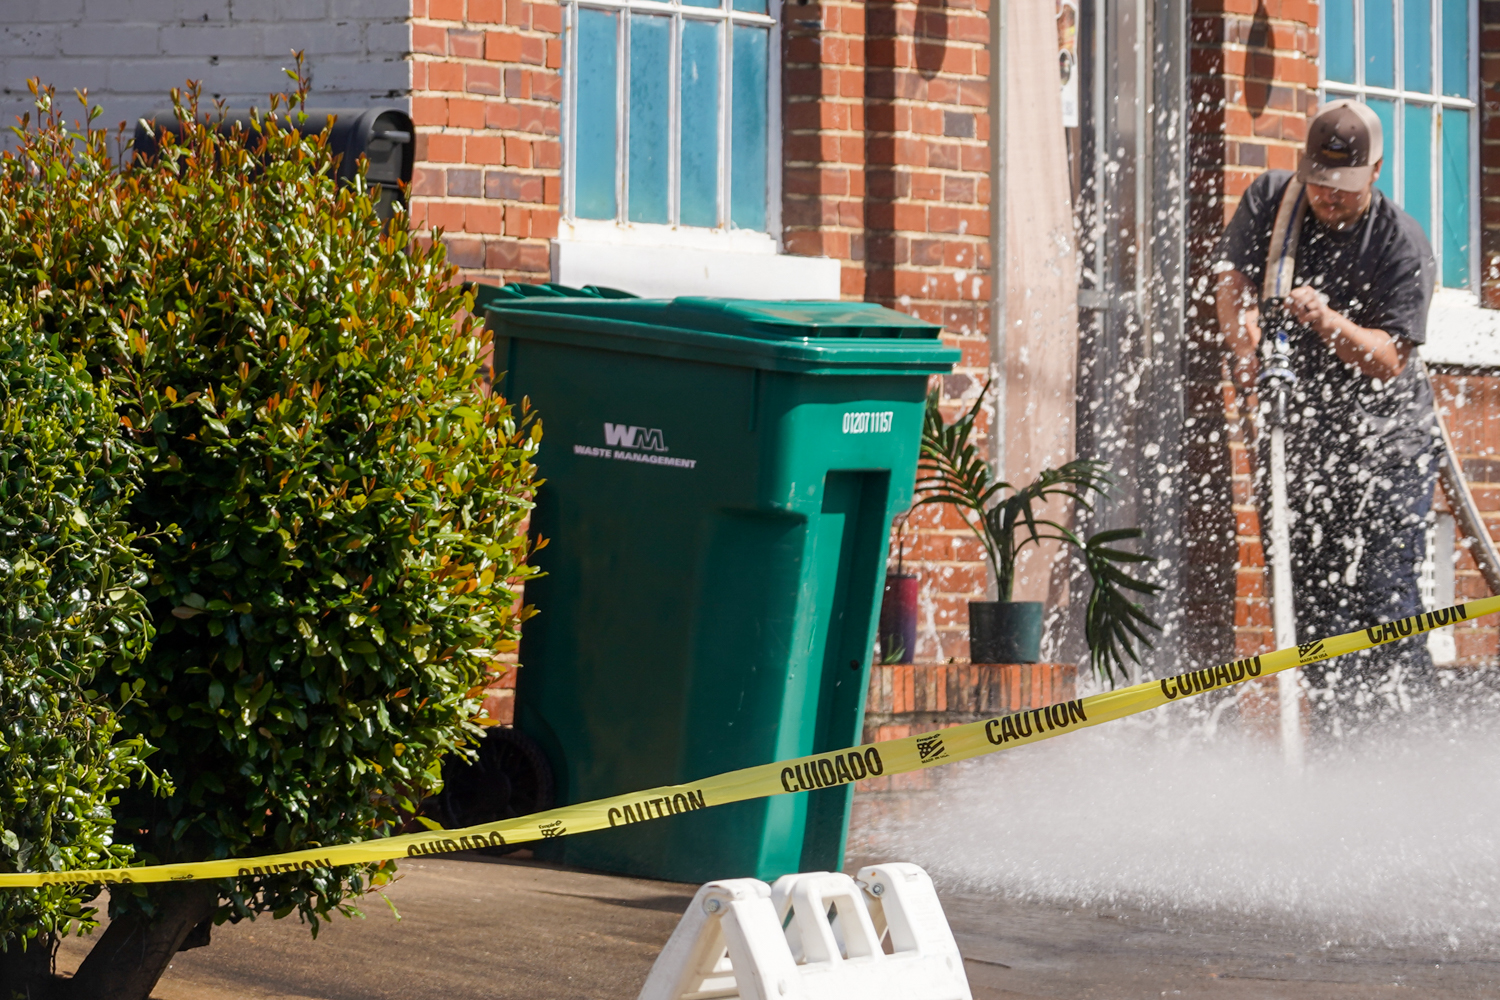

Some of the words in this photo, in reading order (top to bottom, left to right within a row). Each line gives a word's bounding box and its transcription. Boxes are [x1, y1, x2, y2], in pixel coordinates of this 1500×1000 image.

[604, 422, 664, 451] WM
[573, 445, 612, 458] WASTE
[614, 451, 697, 469] MANAGEMENT
[1366, 604, 1468, 644] CAUTION
[1161, 656, 1261, 699] CUIDADO
[985, 699, 1087, 745] CAUTION
[781, 747, 883, 793] CUIDADO
[608, 789, 707, 827] CAUTION
